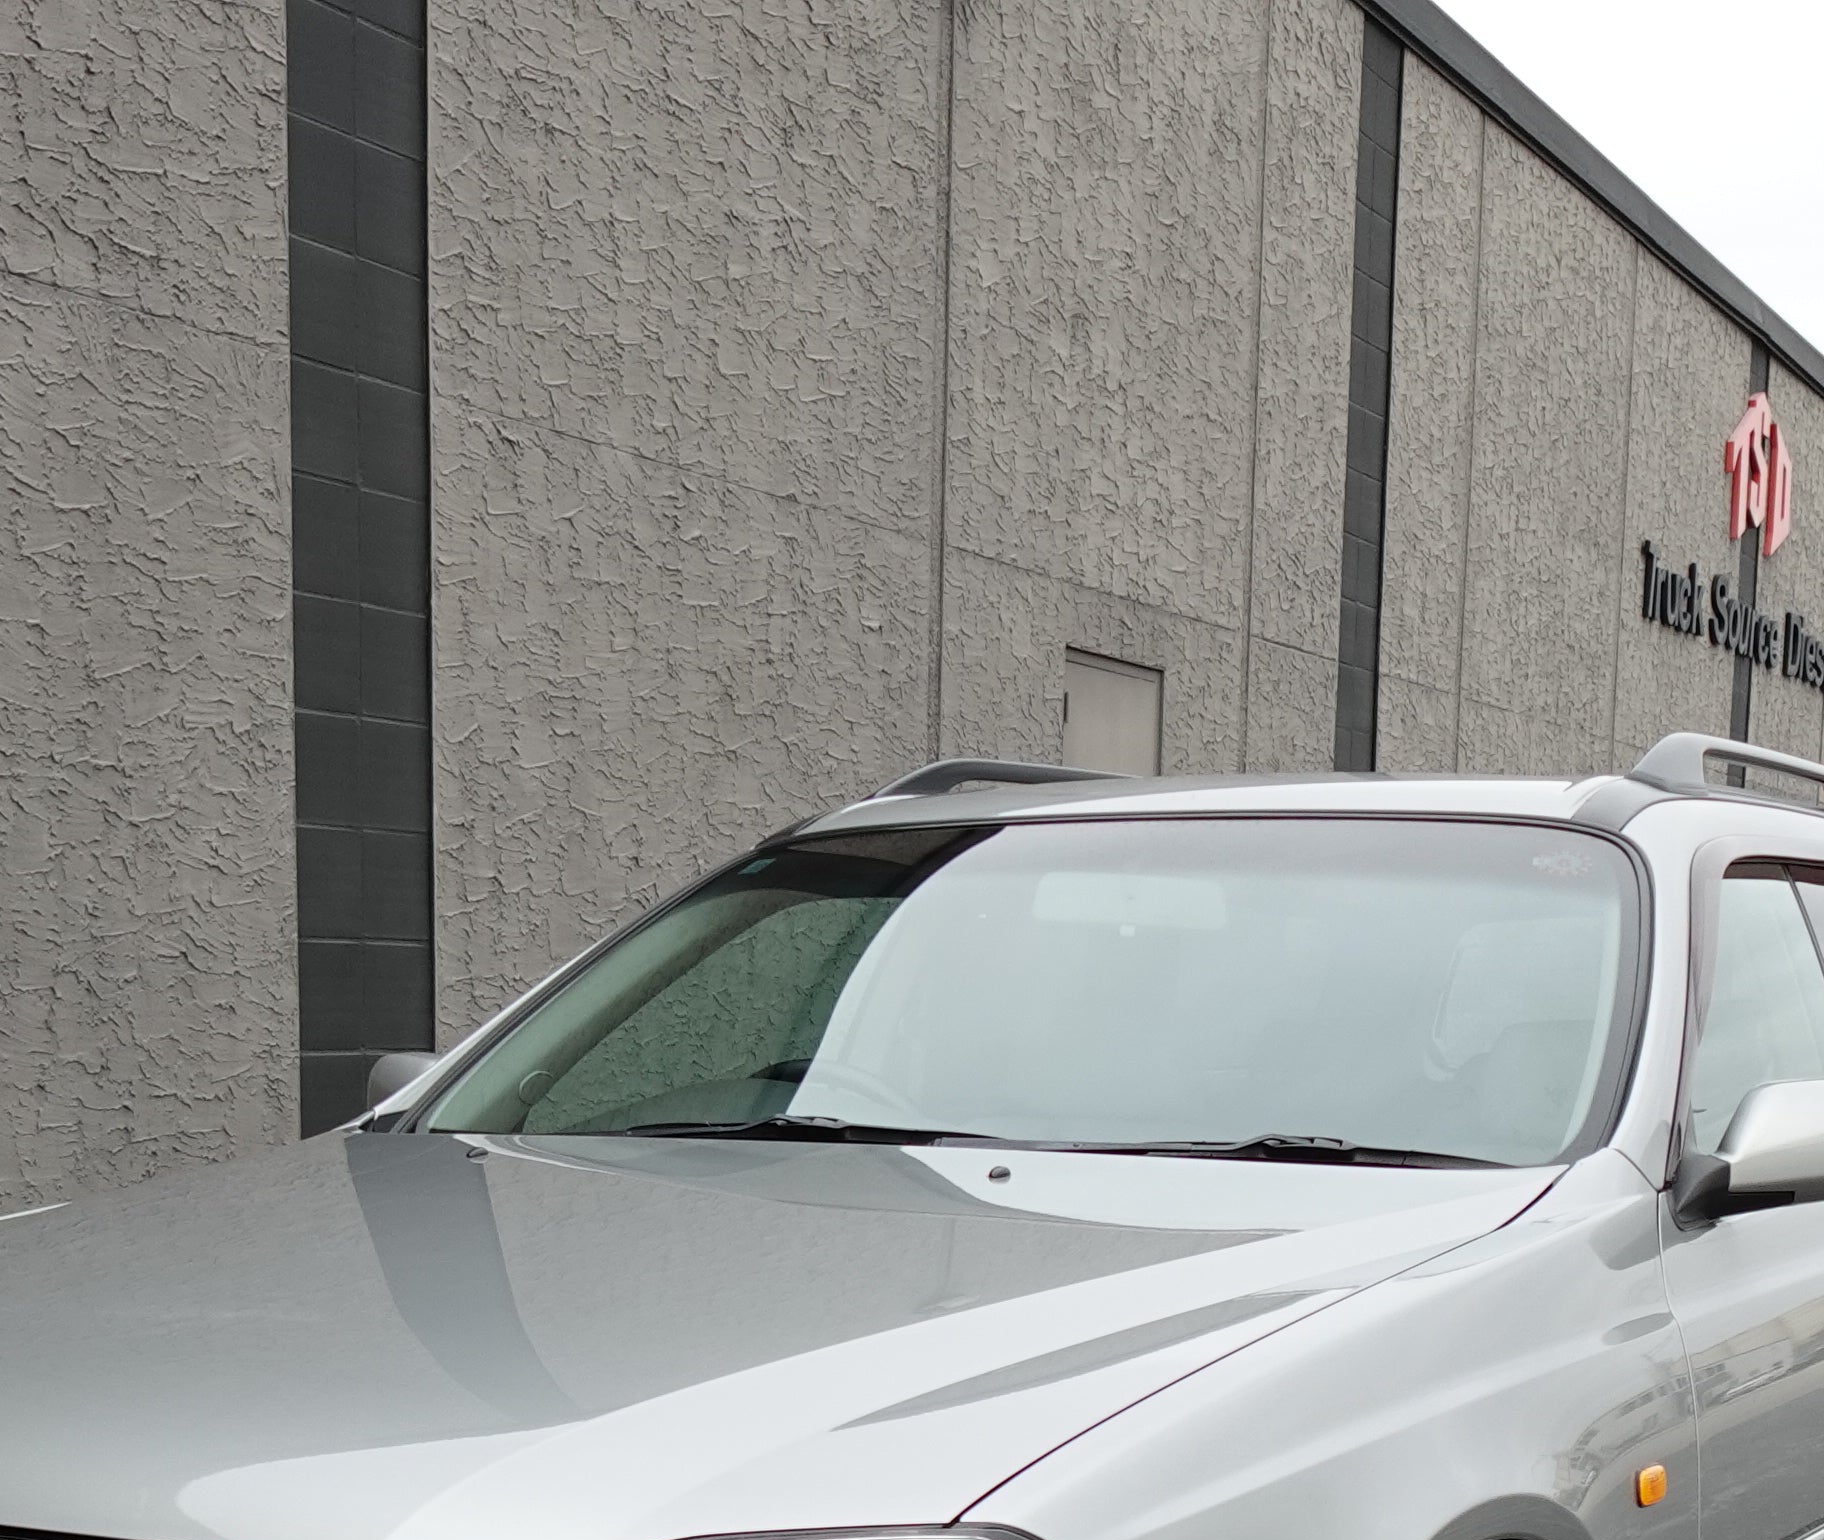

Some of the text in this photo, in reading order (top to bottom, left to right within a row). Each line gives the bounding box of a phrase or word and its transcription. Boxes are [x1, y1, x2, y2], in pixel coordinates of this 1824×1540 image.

[1725, 392, 1792, 557] TSD
[1641, 540, 1705, 636] Truck
[1708, 574, 1780, 670] Source
